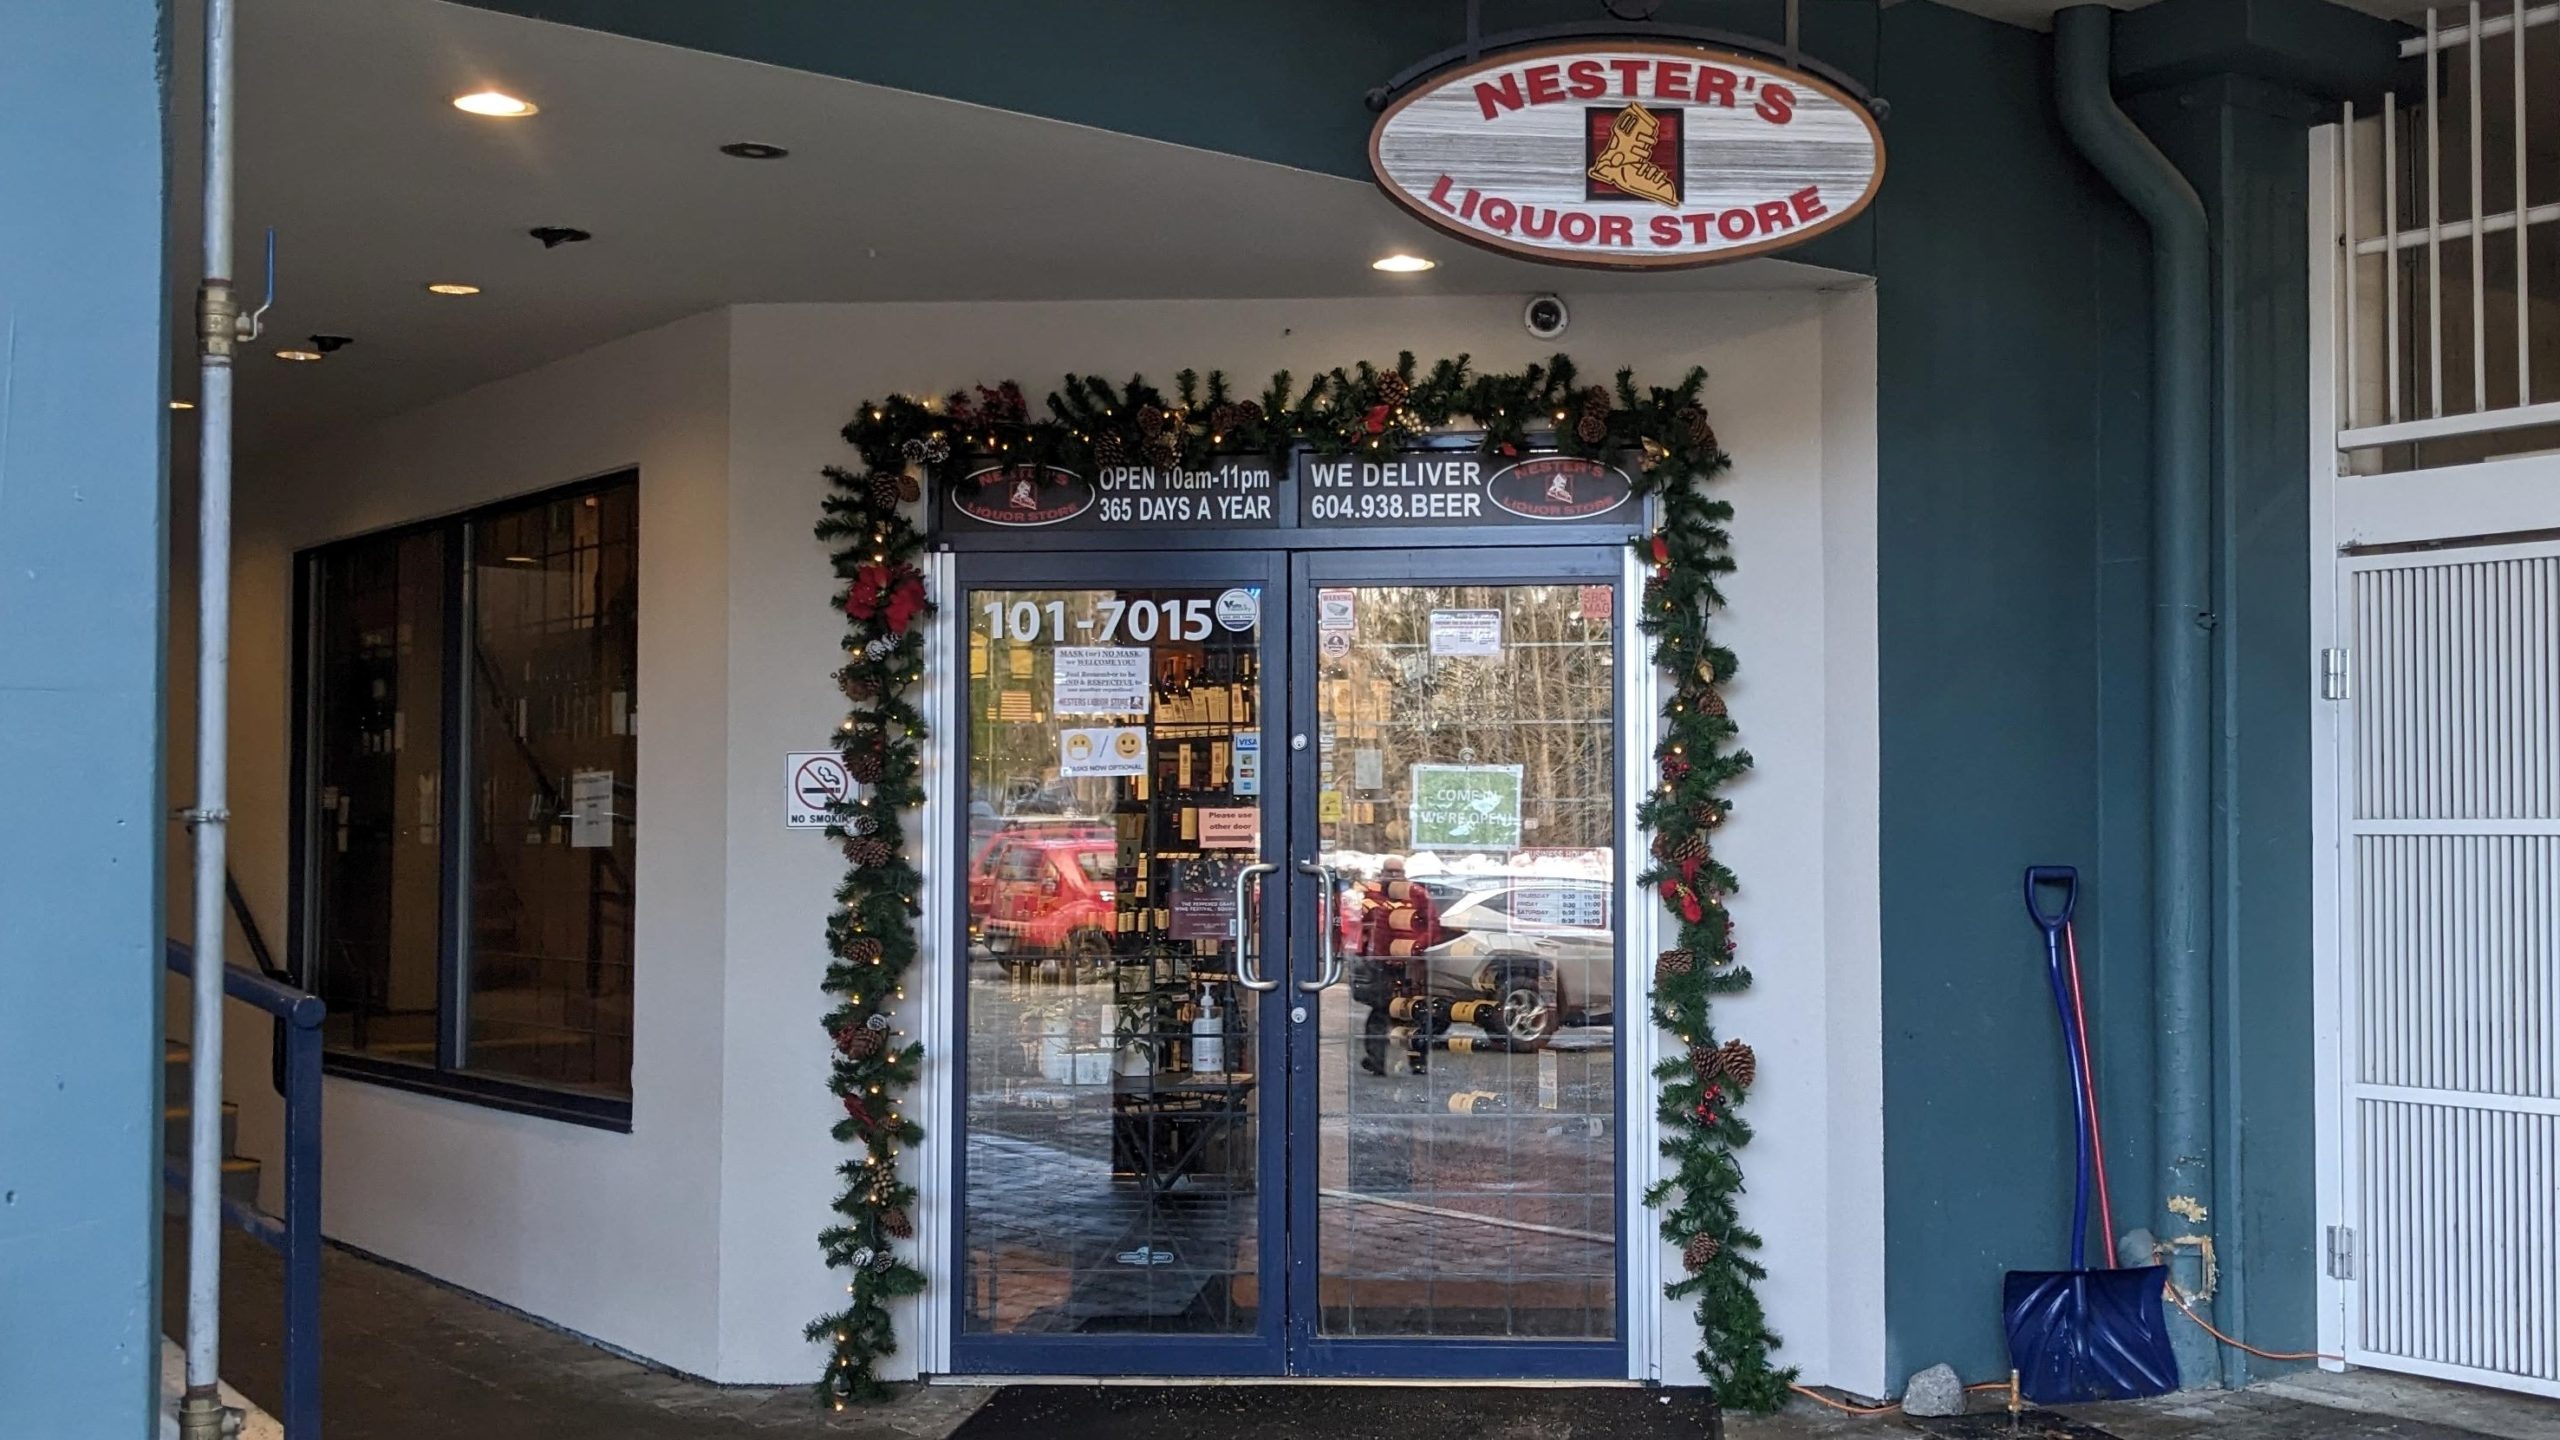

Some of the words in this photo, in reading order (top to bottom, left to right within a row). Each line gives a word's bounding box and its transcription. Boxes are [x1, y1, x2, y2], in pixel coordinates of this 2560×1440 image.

[1472, 59, 1797, 125] NESTER'S
[1428, 174, 1633, 247] LIQUOR
[1649, 185, 1828, 247] STORE
[1100, 466, 1155, 491] OPEN
[1162, 464, 1270, 494] 10am-11pm
[1311, 463, 1354, 488] WE
[1363, 462, 1481, 487] DELIVER
[1514, 461, 1605, 479] NESTER'S
[967, 502, 1025, 521] LIQUOR
[1028, 502, 1078, 521] STORE
[1100, 498, 1132, 522] 365
[1139, 497, 1191, 521] DAYS
[1197, 498, 1212, 520] A
[1218, 496, 1272, 520] YEAR
[1311, 493, 1482, 519] 604.938.BEER
[1503, 496, 1560, 515] LIQUOR
[1563, 496, 1615, 515] STORE
[1437, 789, 1480, 801] COME
[791, 815, 805, 823] NO
